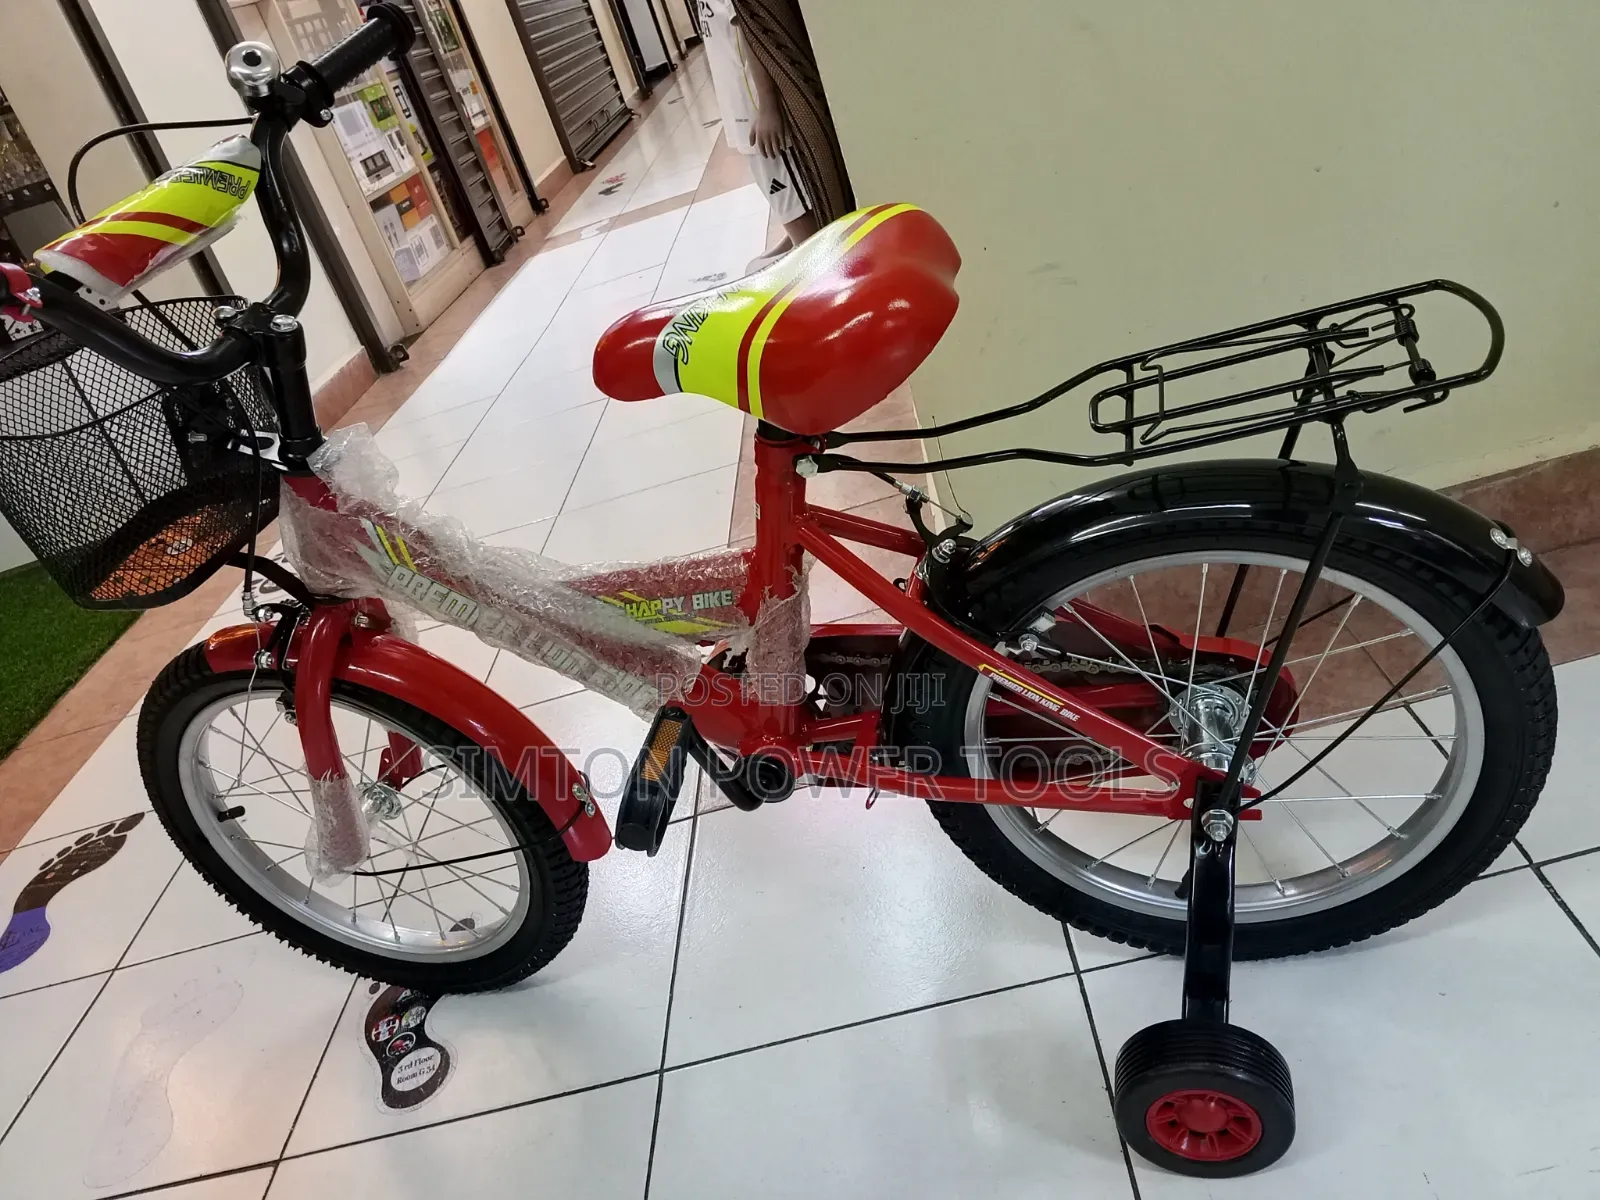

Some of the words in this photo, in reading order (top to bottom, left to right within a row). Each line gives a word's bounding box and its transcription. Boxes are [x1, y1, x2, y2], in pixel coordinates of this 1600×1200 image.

[625, 596, 686, 618] HAPPY
[692, 589, 733, 611] BIKE
[988, 672, 1024, 694] PREMIER
[1020, 689, 1043, 703] LION
[1039, 696, 1061, 713] KING
[1059, 707, 1081, 722] BIKE
[414, 1055, 435, 1067] Floor
[396, 1072, 418, 1084] Room
